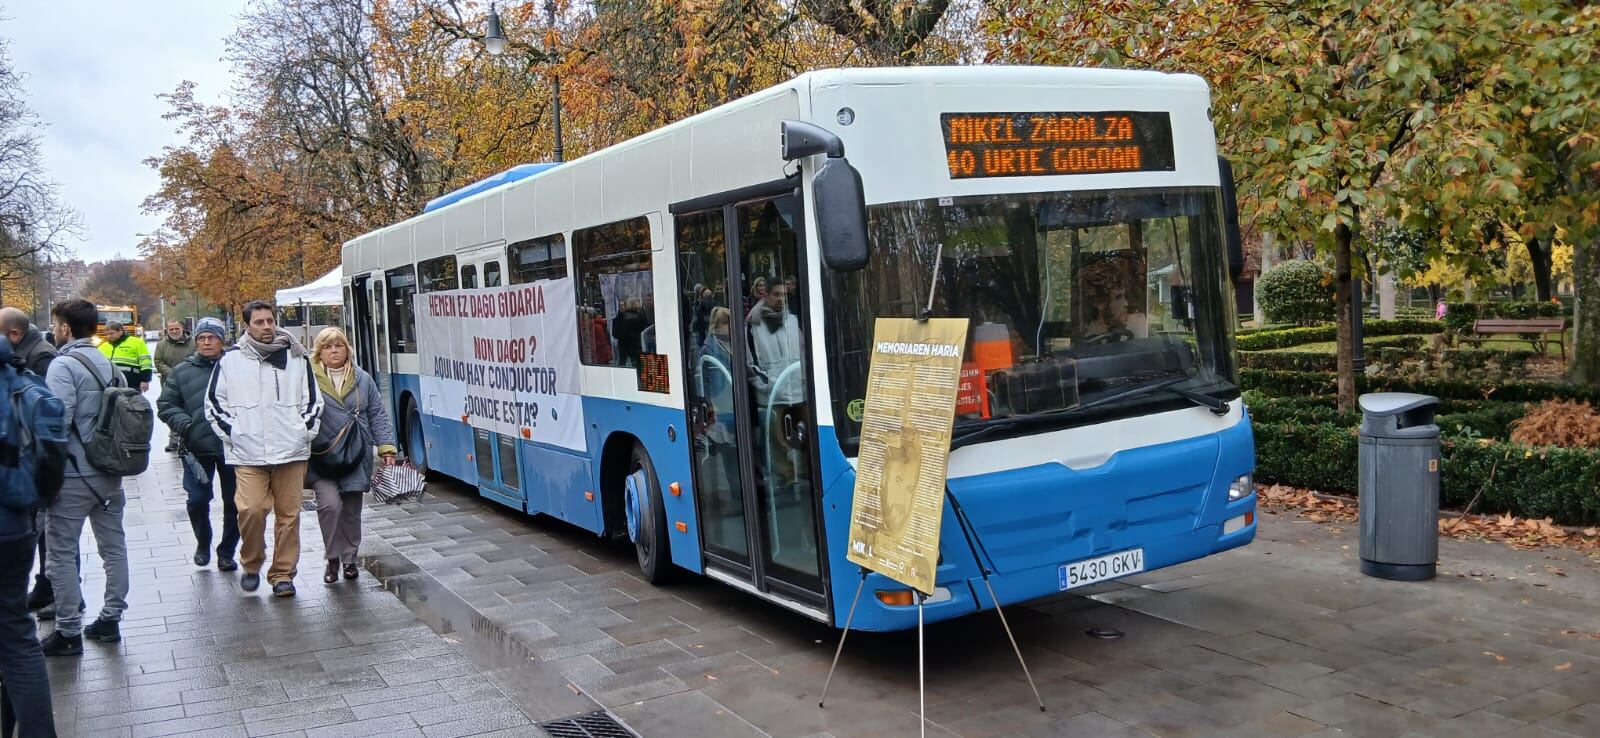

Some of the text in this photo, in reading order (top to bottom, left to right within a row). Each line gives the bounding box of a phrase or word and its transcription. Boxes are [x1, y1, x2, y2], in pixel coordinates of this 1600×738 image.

[950, 114, 1133, 144] MIKEL ZABALZA
[983, 148, 1044, 174] URTE
[1052, 145, 1140, 171] GOGOAN
[429, 285, 546, 318] HEMEN EZ DAGO GIDARIA
[473, 335, 537, 364] NON DAGO ?
[876, 341, 960, 357] MEMORIAREN HARIA
[434, 356, 557, 396] AQUI NO HAY CONDUCTOR
[464, 395, 499, 420] ¿DONDE
[1069, 551, 1139, 584] 5430 GKV
